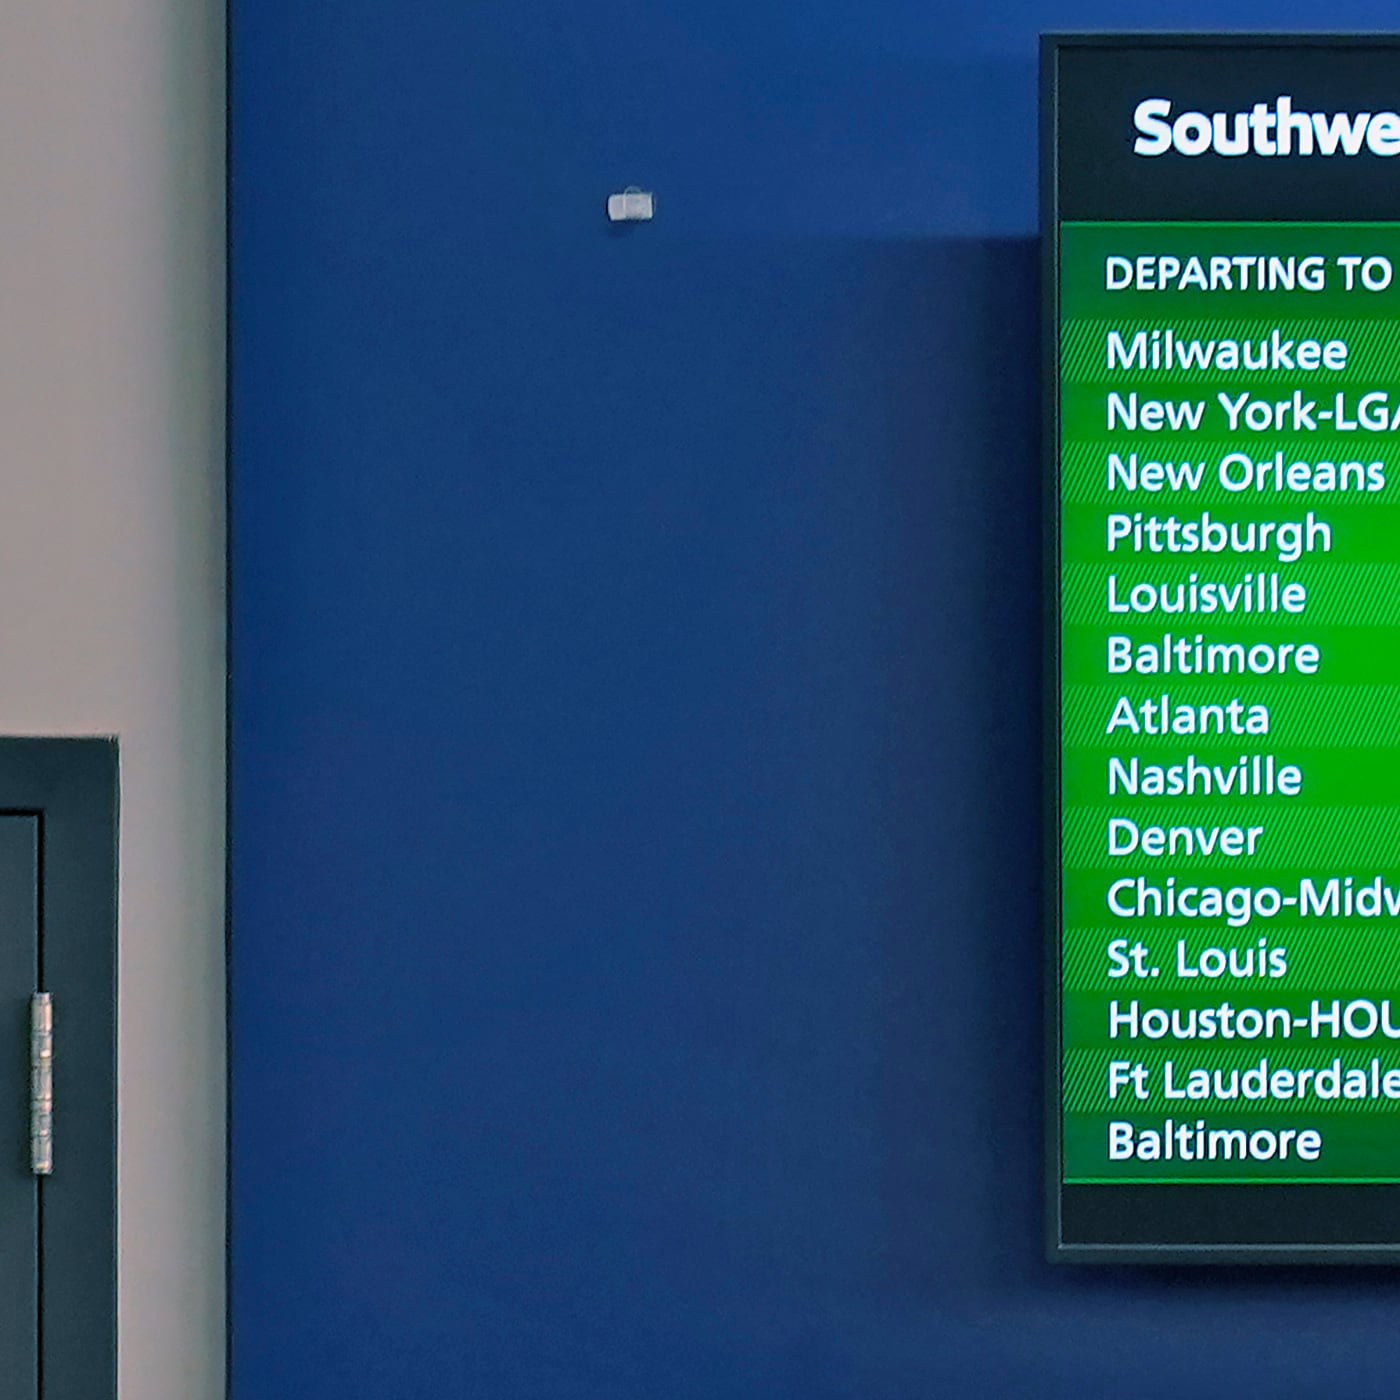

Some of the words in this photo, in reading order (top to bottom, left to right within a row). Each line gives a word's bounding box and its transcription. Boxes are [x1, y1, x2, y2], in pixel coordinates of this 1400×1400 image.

[1106, 256, 1325, 291] DEPARTING
[1336, 256, 1392, 291] TO
[1107, 329, 1348, 370] Milwaukee
[1107, 392, 1205, 431] New
[1108, 453, 1205, 491] New
[1219, 451, 1385, 492] Orleans
[1107, 512, 1331, 563] Pittsburgh
[1108, 572, 1306, 613] Louisville
[1108, 633, 1320, 674] Baltimore
[1106, 694, 1269, 735] Atlanta
[1109, 755, 1302, 796] Nashville
[1108, 819, 1264, 856] Denver
[1107, 939, 1160, 978] St.
[1177, 938, 1287, 978] Louis
[1109, 1061, 1150, 1099] Ft
[1109, 1119, 1322, 1160] Baltimore
